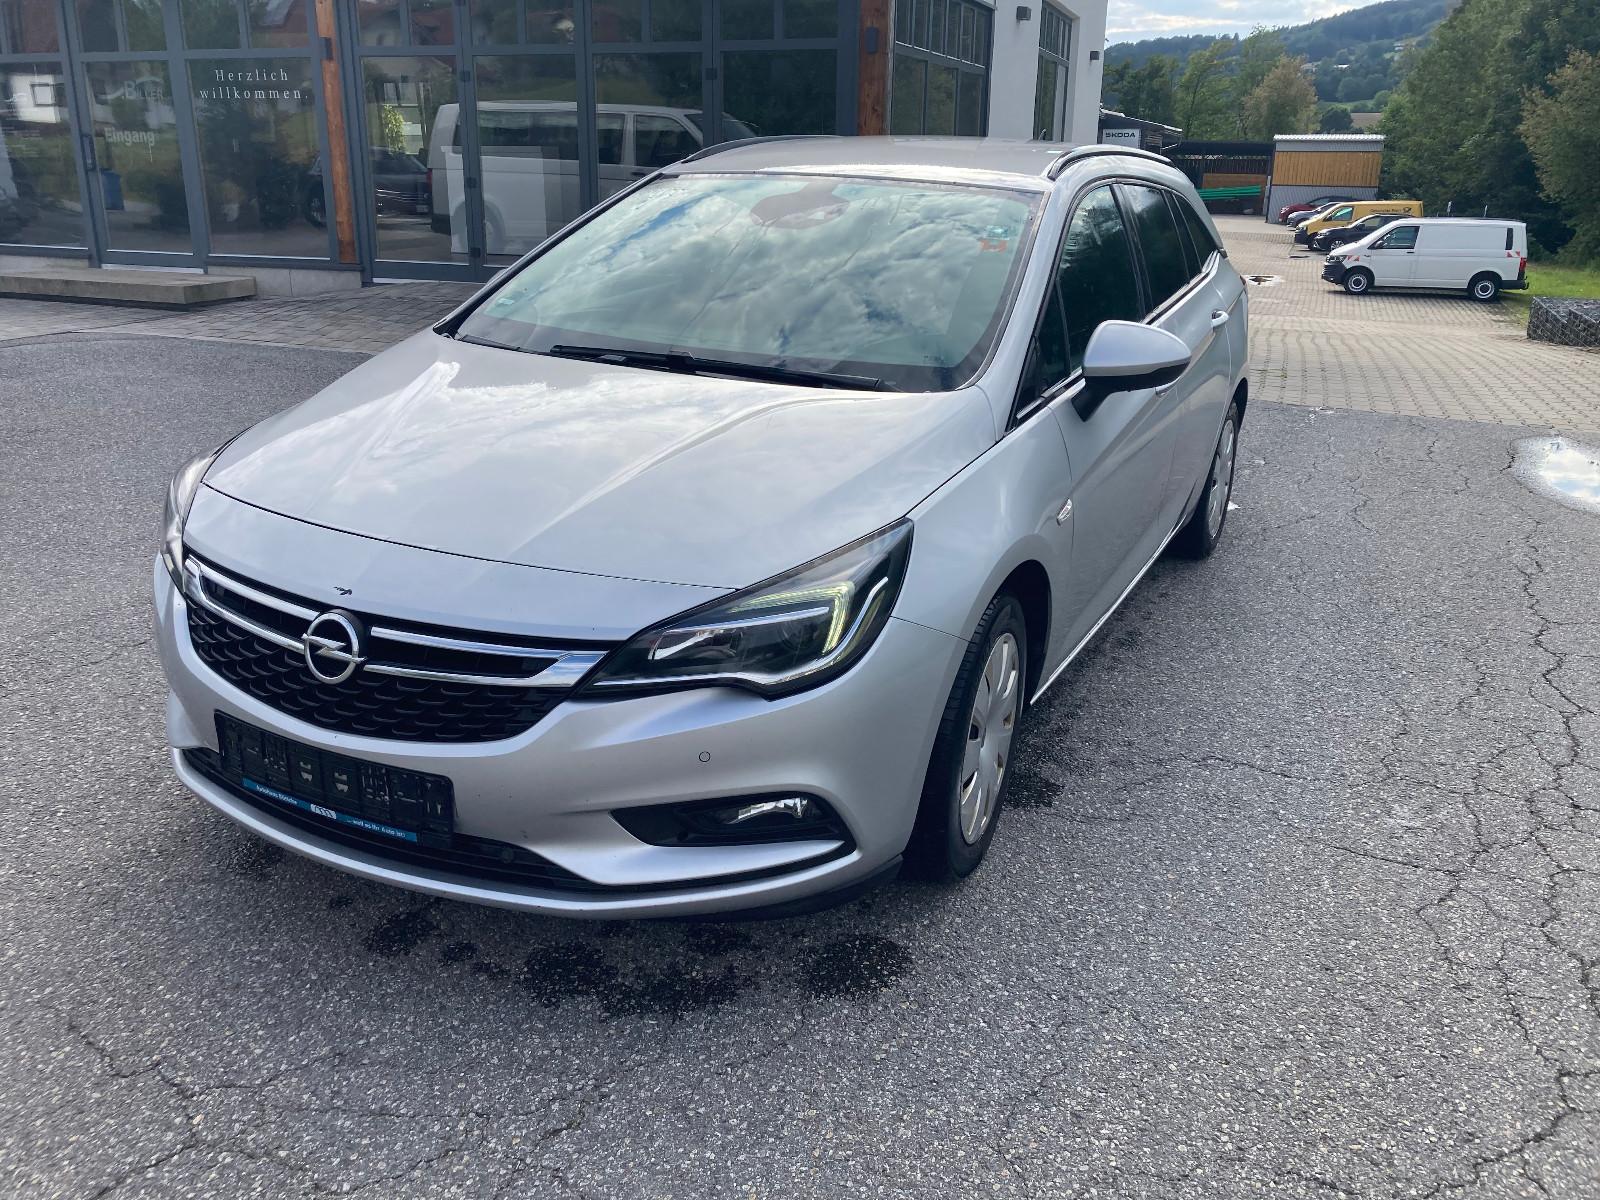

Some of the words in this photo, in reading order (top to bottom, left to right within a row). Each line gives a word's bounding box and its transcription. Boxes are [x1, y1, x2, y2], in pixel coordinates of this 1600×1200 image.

[215, 68, 288, 81] Herzlich
[199, 86, 309, 99] willkommen.
[104, 127, 155, 146] Eingang
